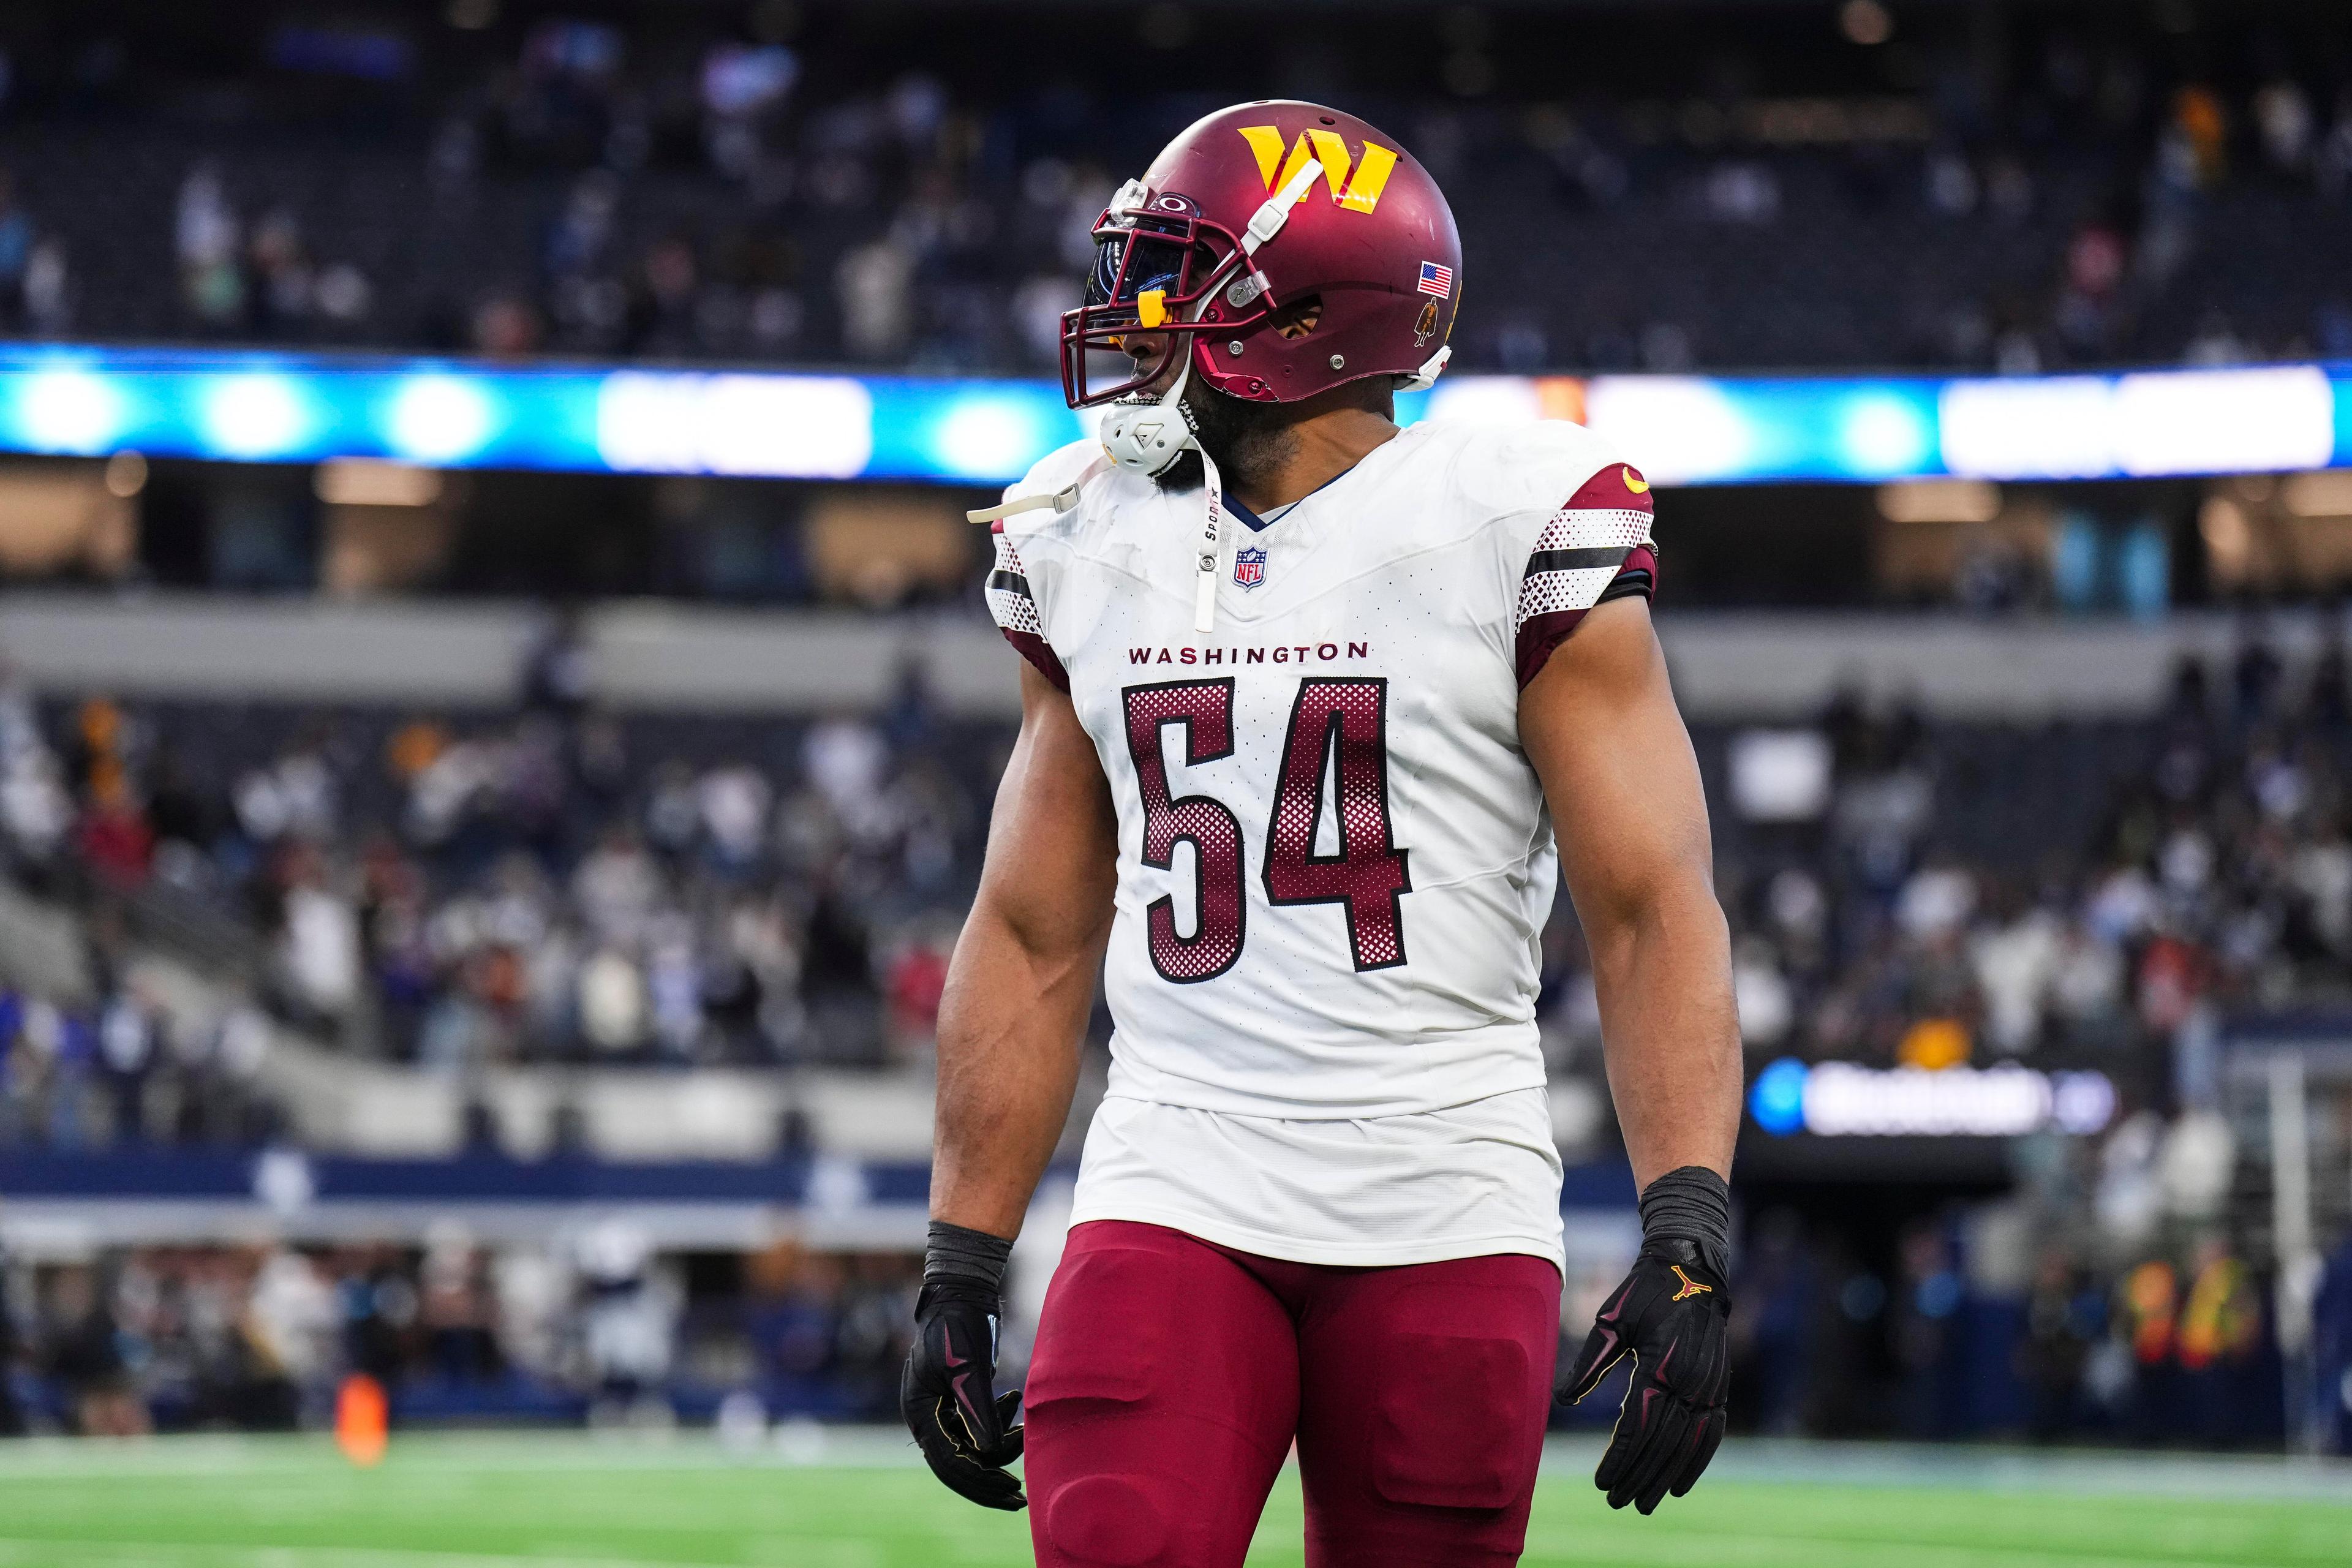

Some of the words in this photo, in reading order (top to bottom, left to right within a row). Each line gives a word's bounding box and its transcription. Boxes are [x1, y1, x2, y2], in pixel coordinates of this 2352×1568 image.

[1237, 564, 1261, 582] NFL
[1129, 642, 1368, 665] WASHINGTON
[1122, 676, 1412, 984] 54
